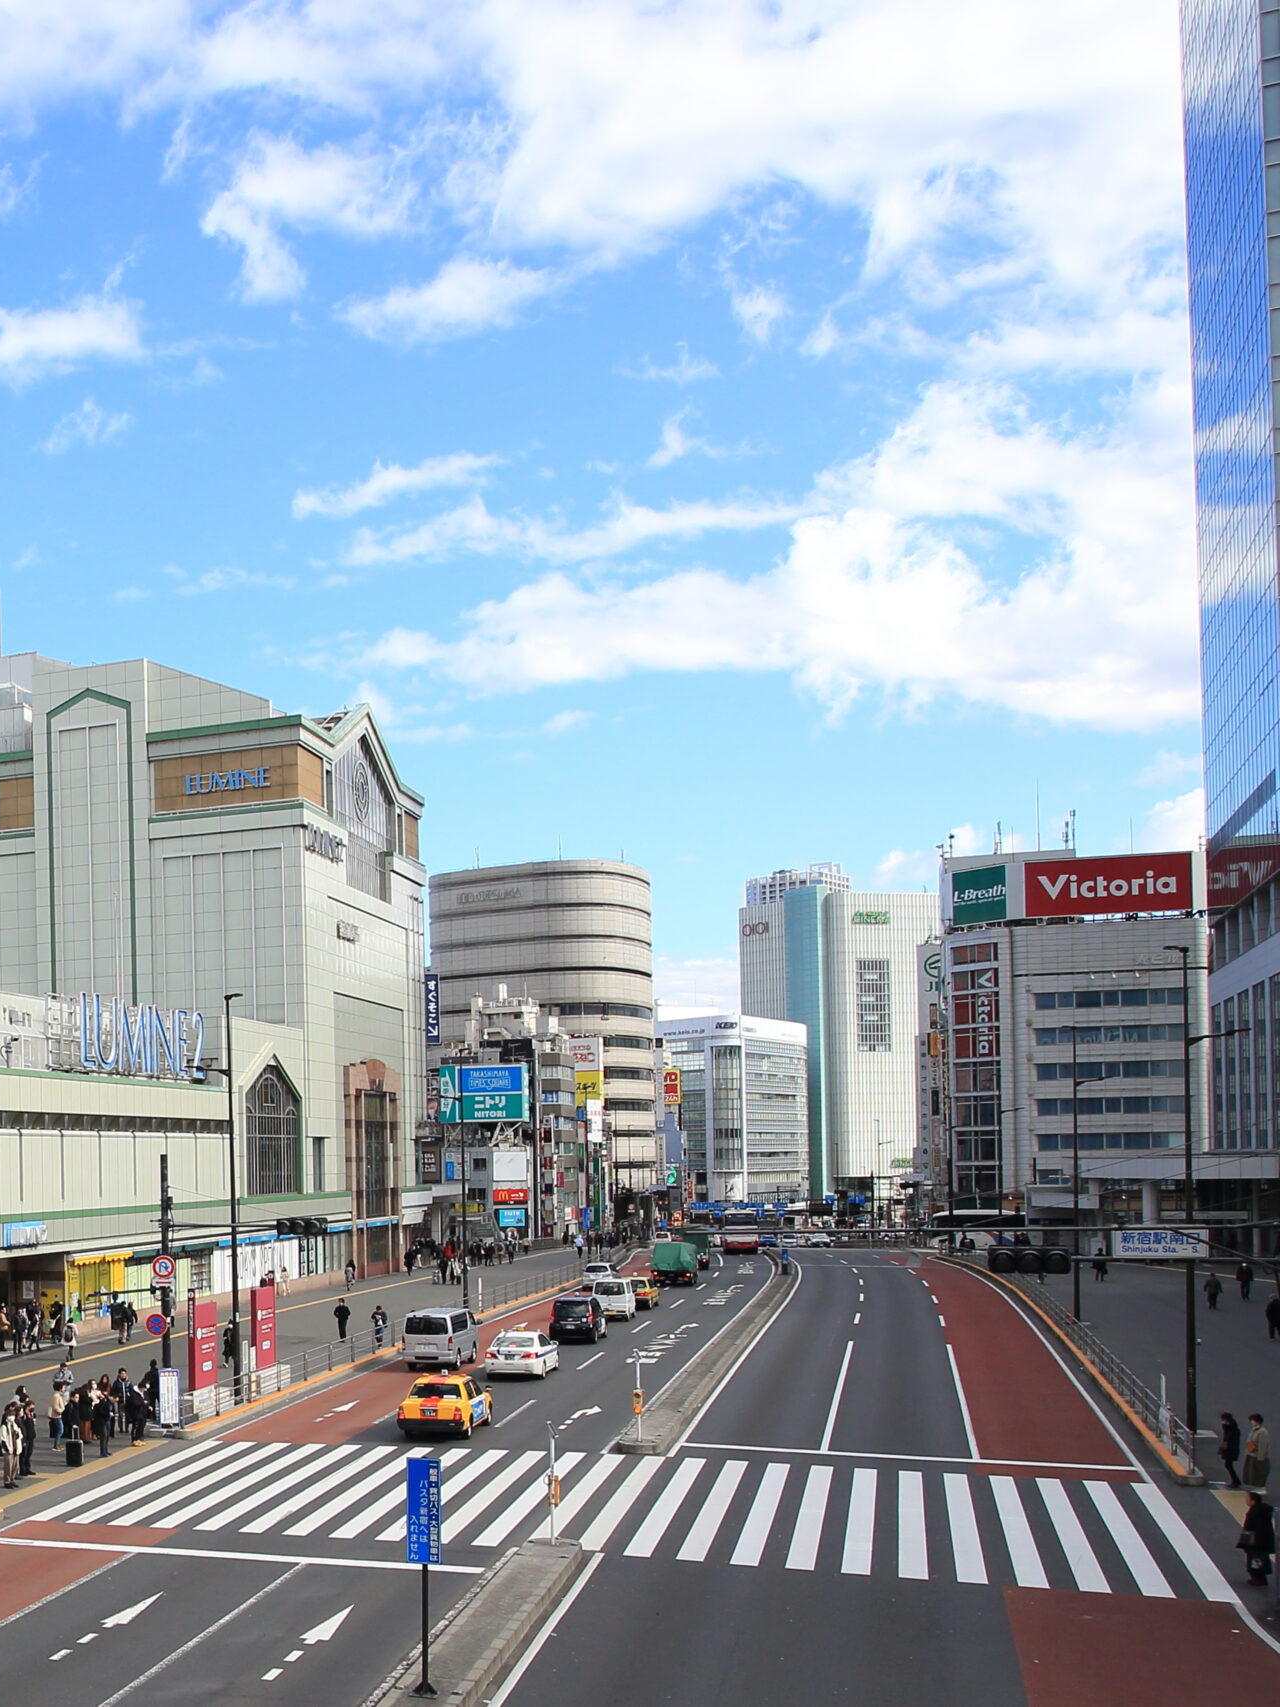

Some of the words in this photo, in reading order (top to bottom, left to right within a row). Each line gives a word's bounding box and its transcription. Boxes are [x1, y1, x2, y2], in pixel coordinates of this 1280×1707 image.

[185, 765, 270, 795] LUMINE
[953, 884, 1006, 902] L-Breath
[1037, 870, 1177, 900] Victoria
[80, 992, 188, 1077] LUMINE
[193, 1012, 206, 1079] 2
[470, 1070, 509, 1078] TAKASHIMAYA
[474, 1095, 506, 1108] ニトリ
[474, 1110, 506, 1118] NITORI
[1121, 1232, 1200, 1245] 新宿駅南口
[1122, 1245, 1158, 1254] Shinjuku
[1162, 1245, 1178, 1253] Sta.
[419, 1480, 428, 1543] バスタ新宿へは
[410, 1515, 419, 1560] 入れません
